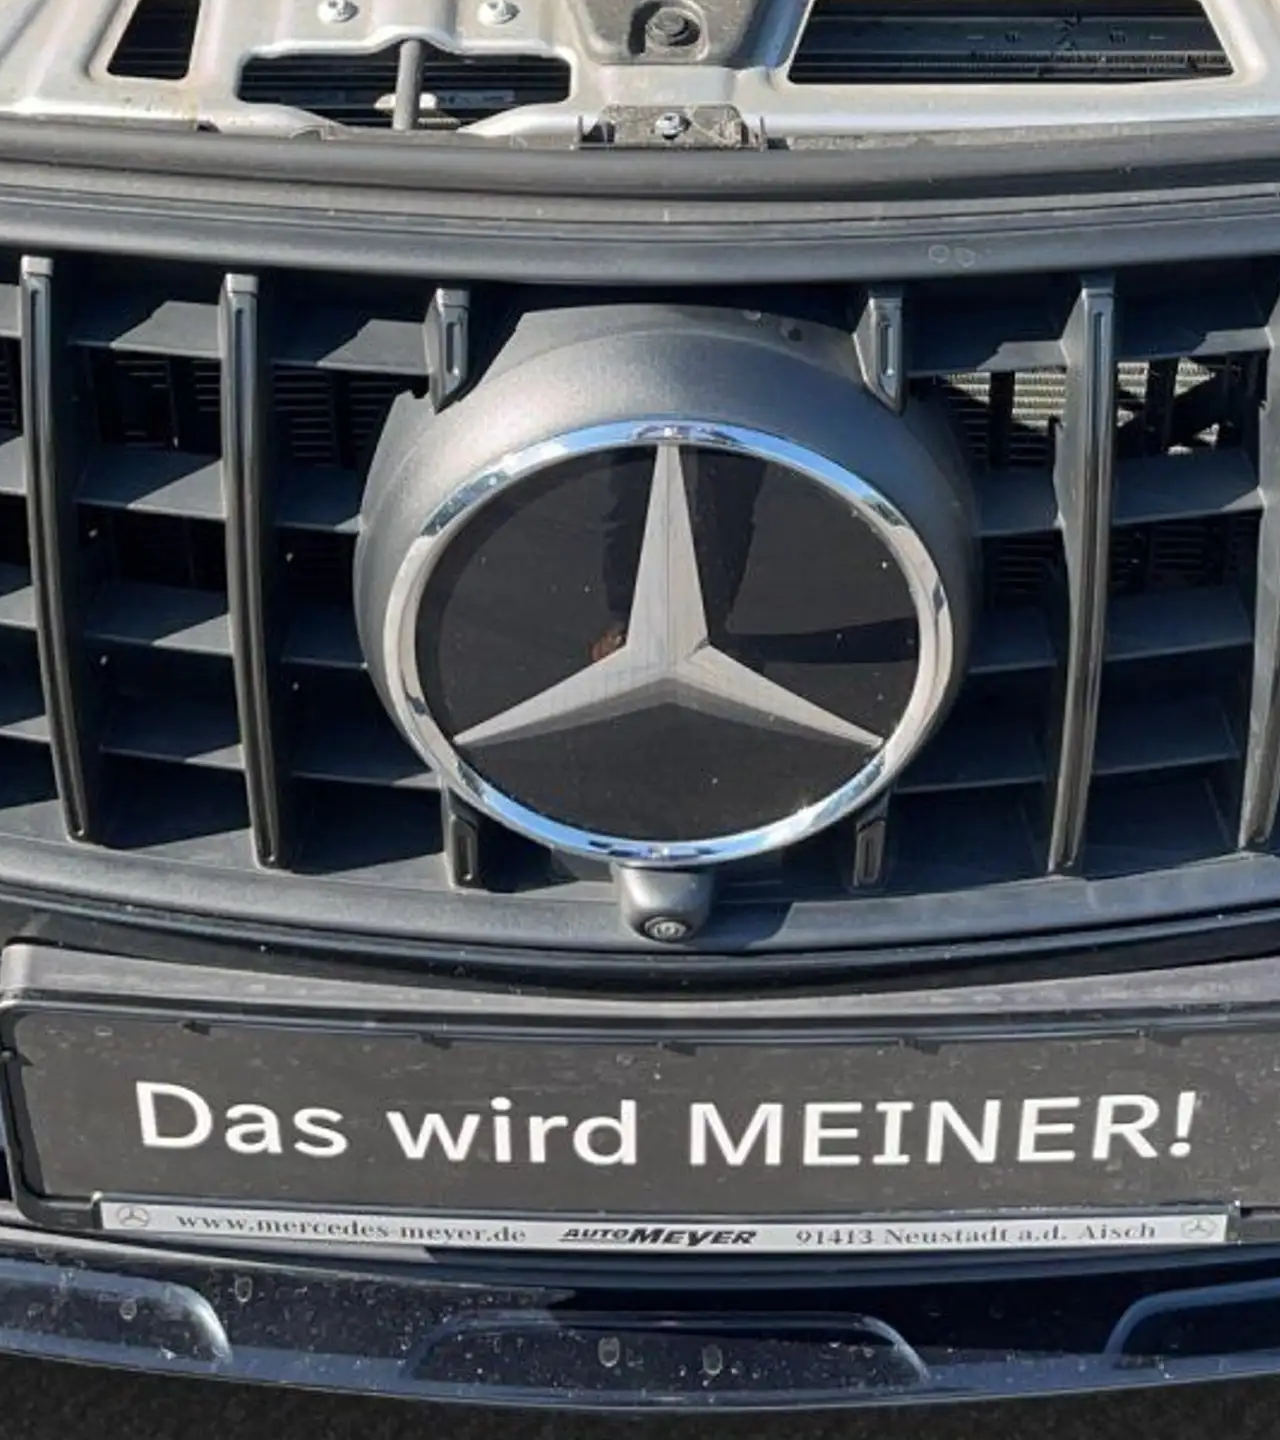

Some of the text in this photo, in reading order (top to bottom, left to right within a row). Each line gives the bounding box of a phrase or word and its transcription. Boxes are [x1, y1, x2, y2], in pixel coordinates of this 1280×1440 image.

[136, 1081, 1196, 1166] Das wird MEINER!
[176, 1215, 526, 1245] www.mercedes-meyer.de
[796, 1228, 873, 1246] 91413
[884, 1224, 1008, 1245] Neustadt
[1078, 1221, 1156, 1241] Aisch
